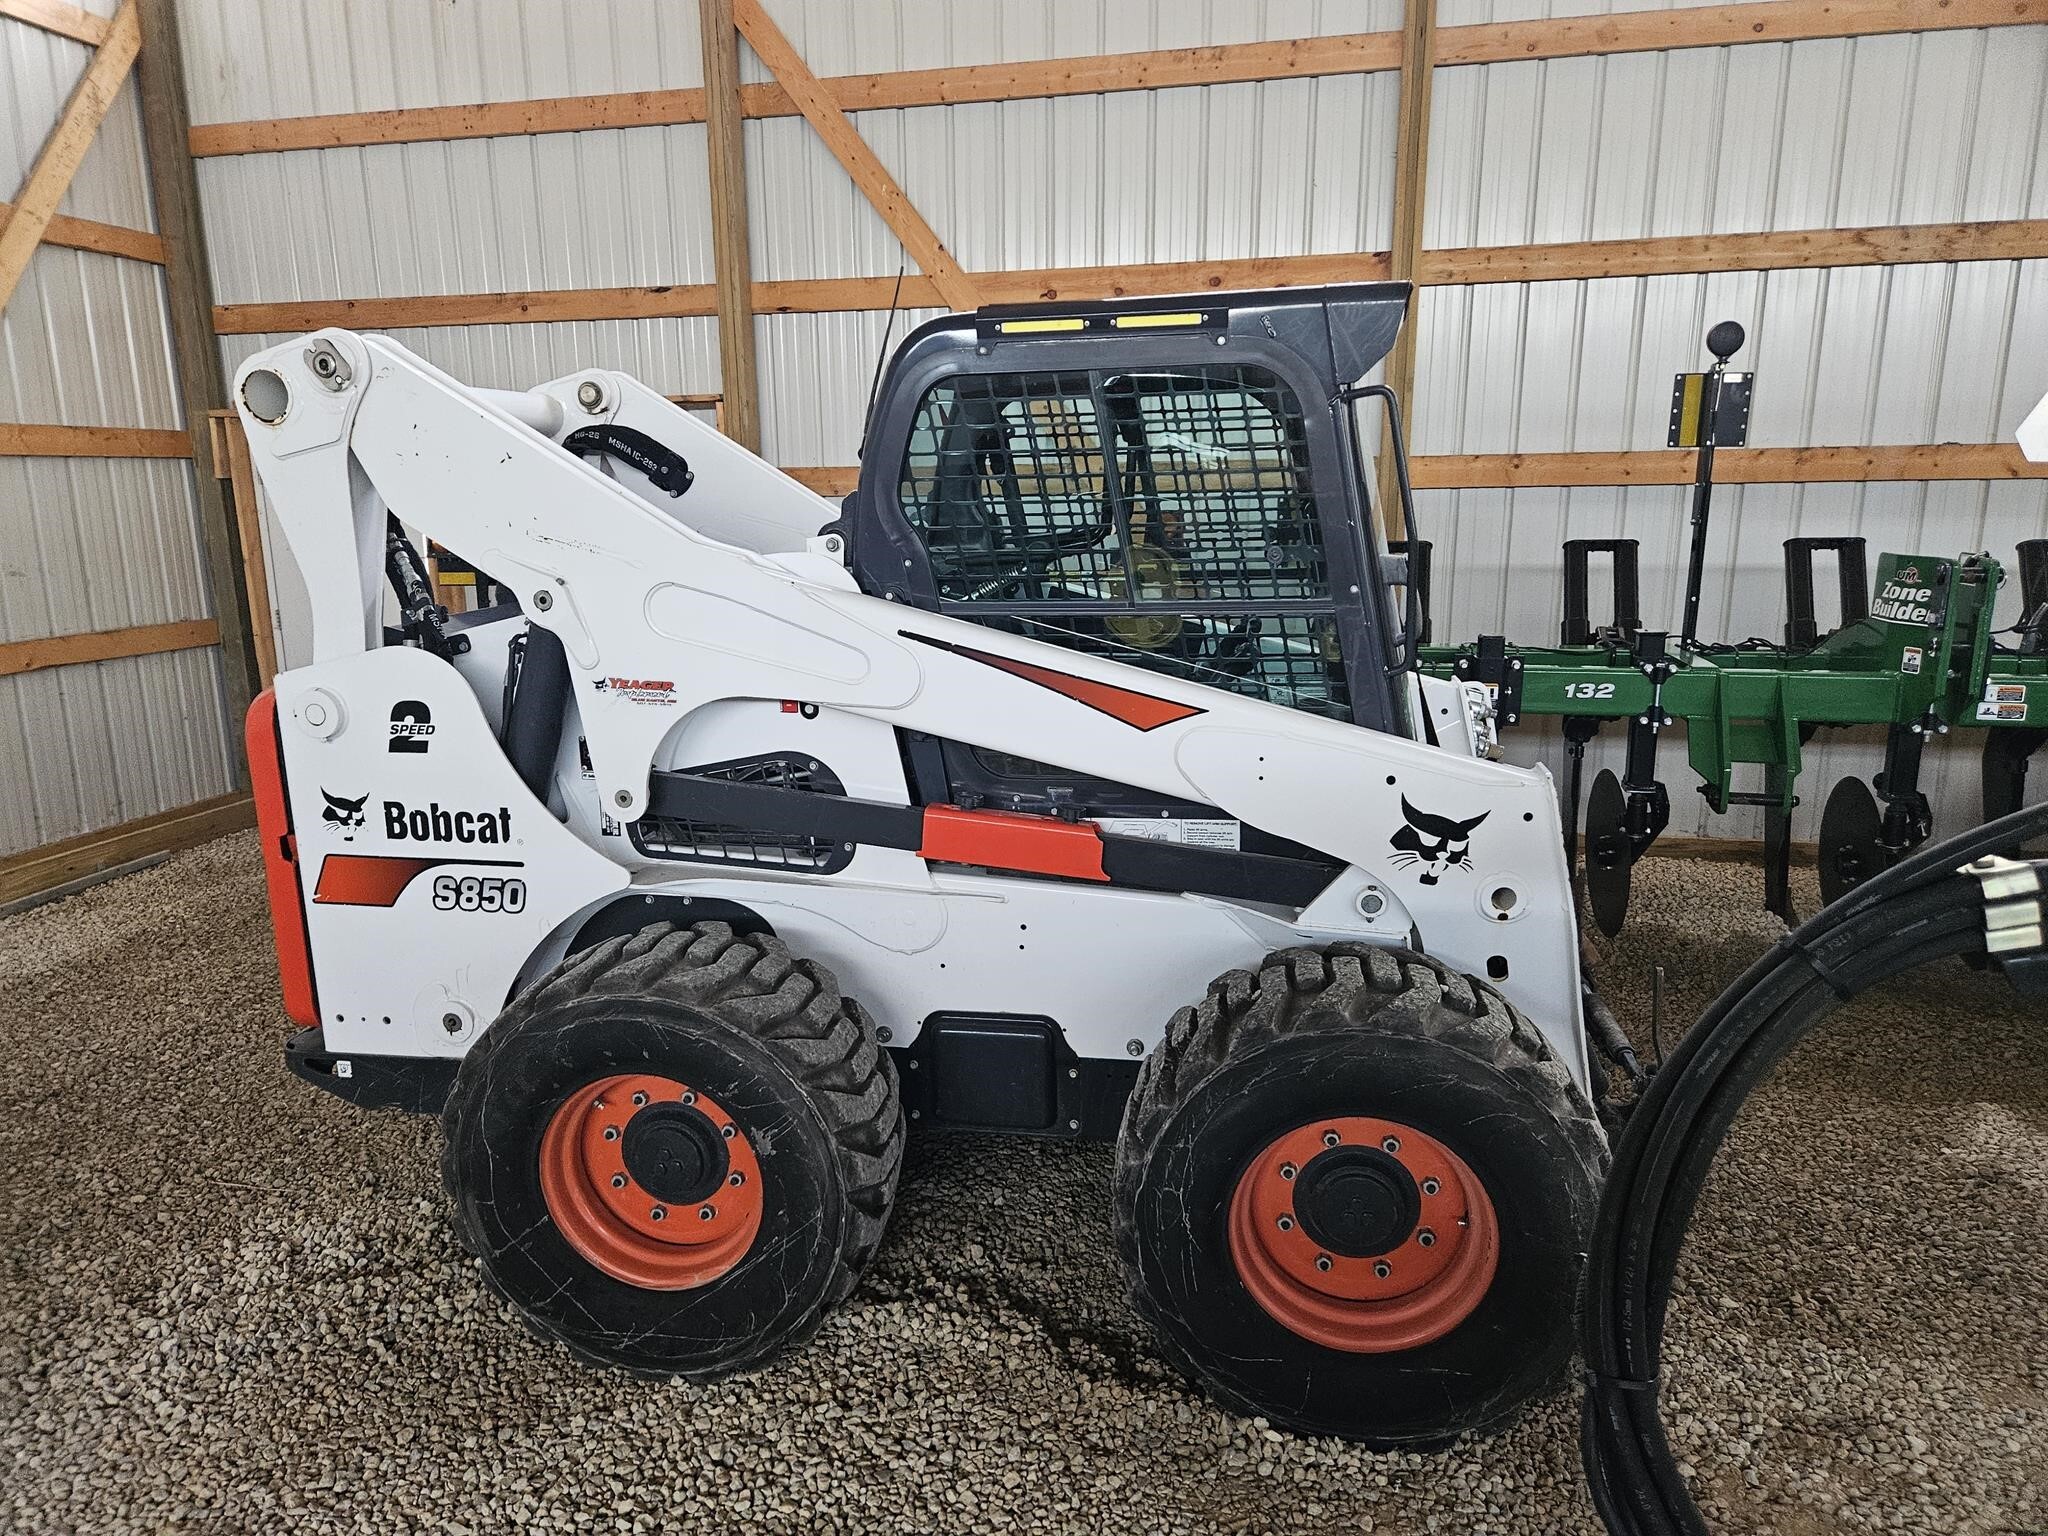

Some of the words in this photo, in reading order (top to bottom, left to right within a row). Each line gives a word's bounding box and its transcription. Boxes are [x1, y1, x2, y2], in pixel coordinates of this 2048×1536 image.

[608, 437, 632, 456] MSHA
[1882, 582, 1932, 602] Zone
[608, 677, 676, 692] YEAGER
[1565, 683, 1616, 698] 132
[388, 700, 431, 753] 2
[390, 724, 436, 735] SPEED
[383, 801, 511, 843] Bobcat
[432, 875, 527, 914] S850
